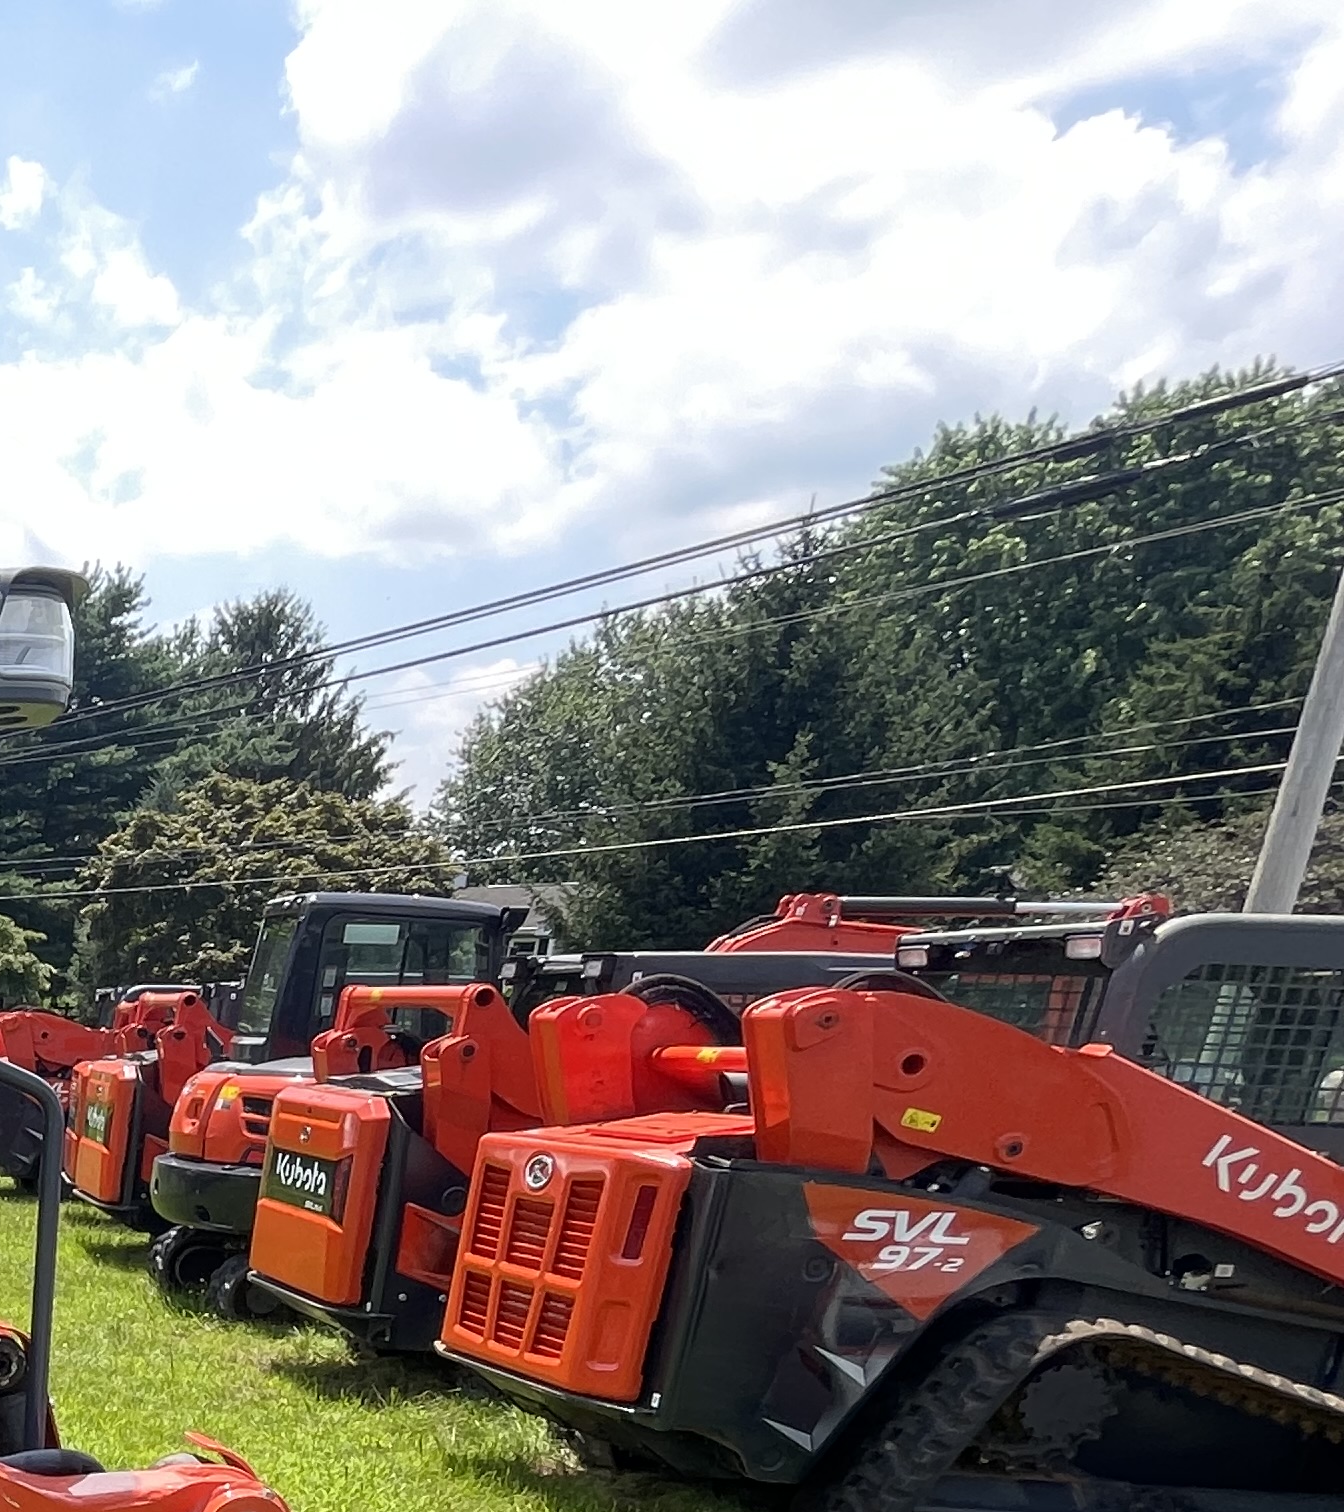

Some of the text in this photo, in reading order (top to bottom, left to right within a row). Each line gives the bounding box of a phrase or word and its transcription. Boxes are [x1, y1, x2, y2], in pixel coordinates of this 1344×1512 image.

[275, 1152, 327, 1195] Kubota
[841, 1208, 970, 1245] SVL
[870, 1245, 965, 1272] 97-2
